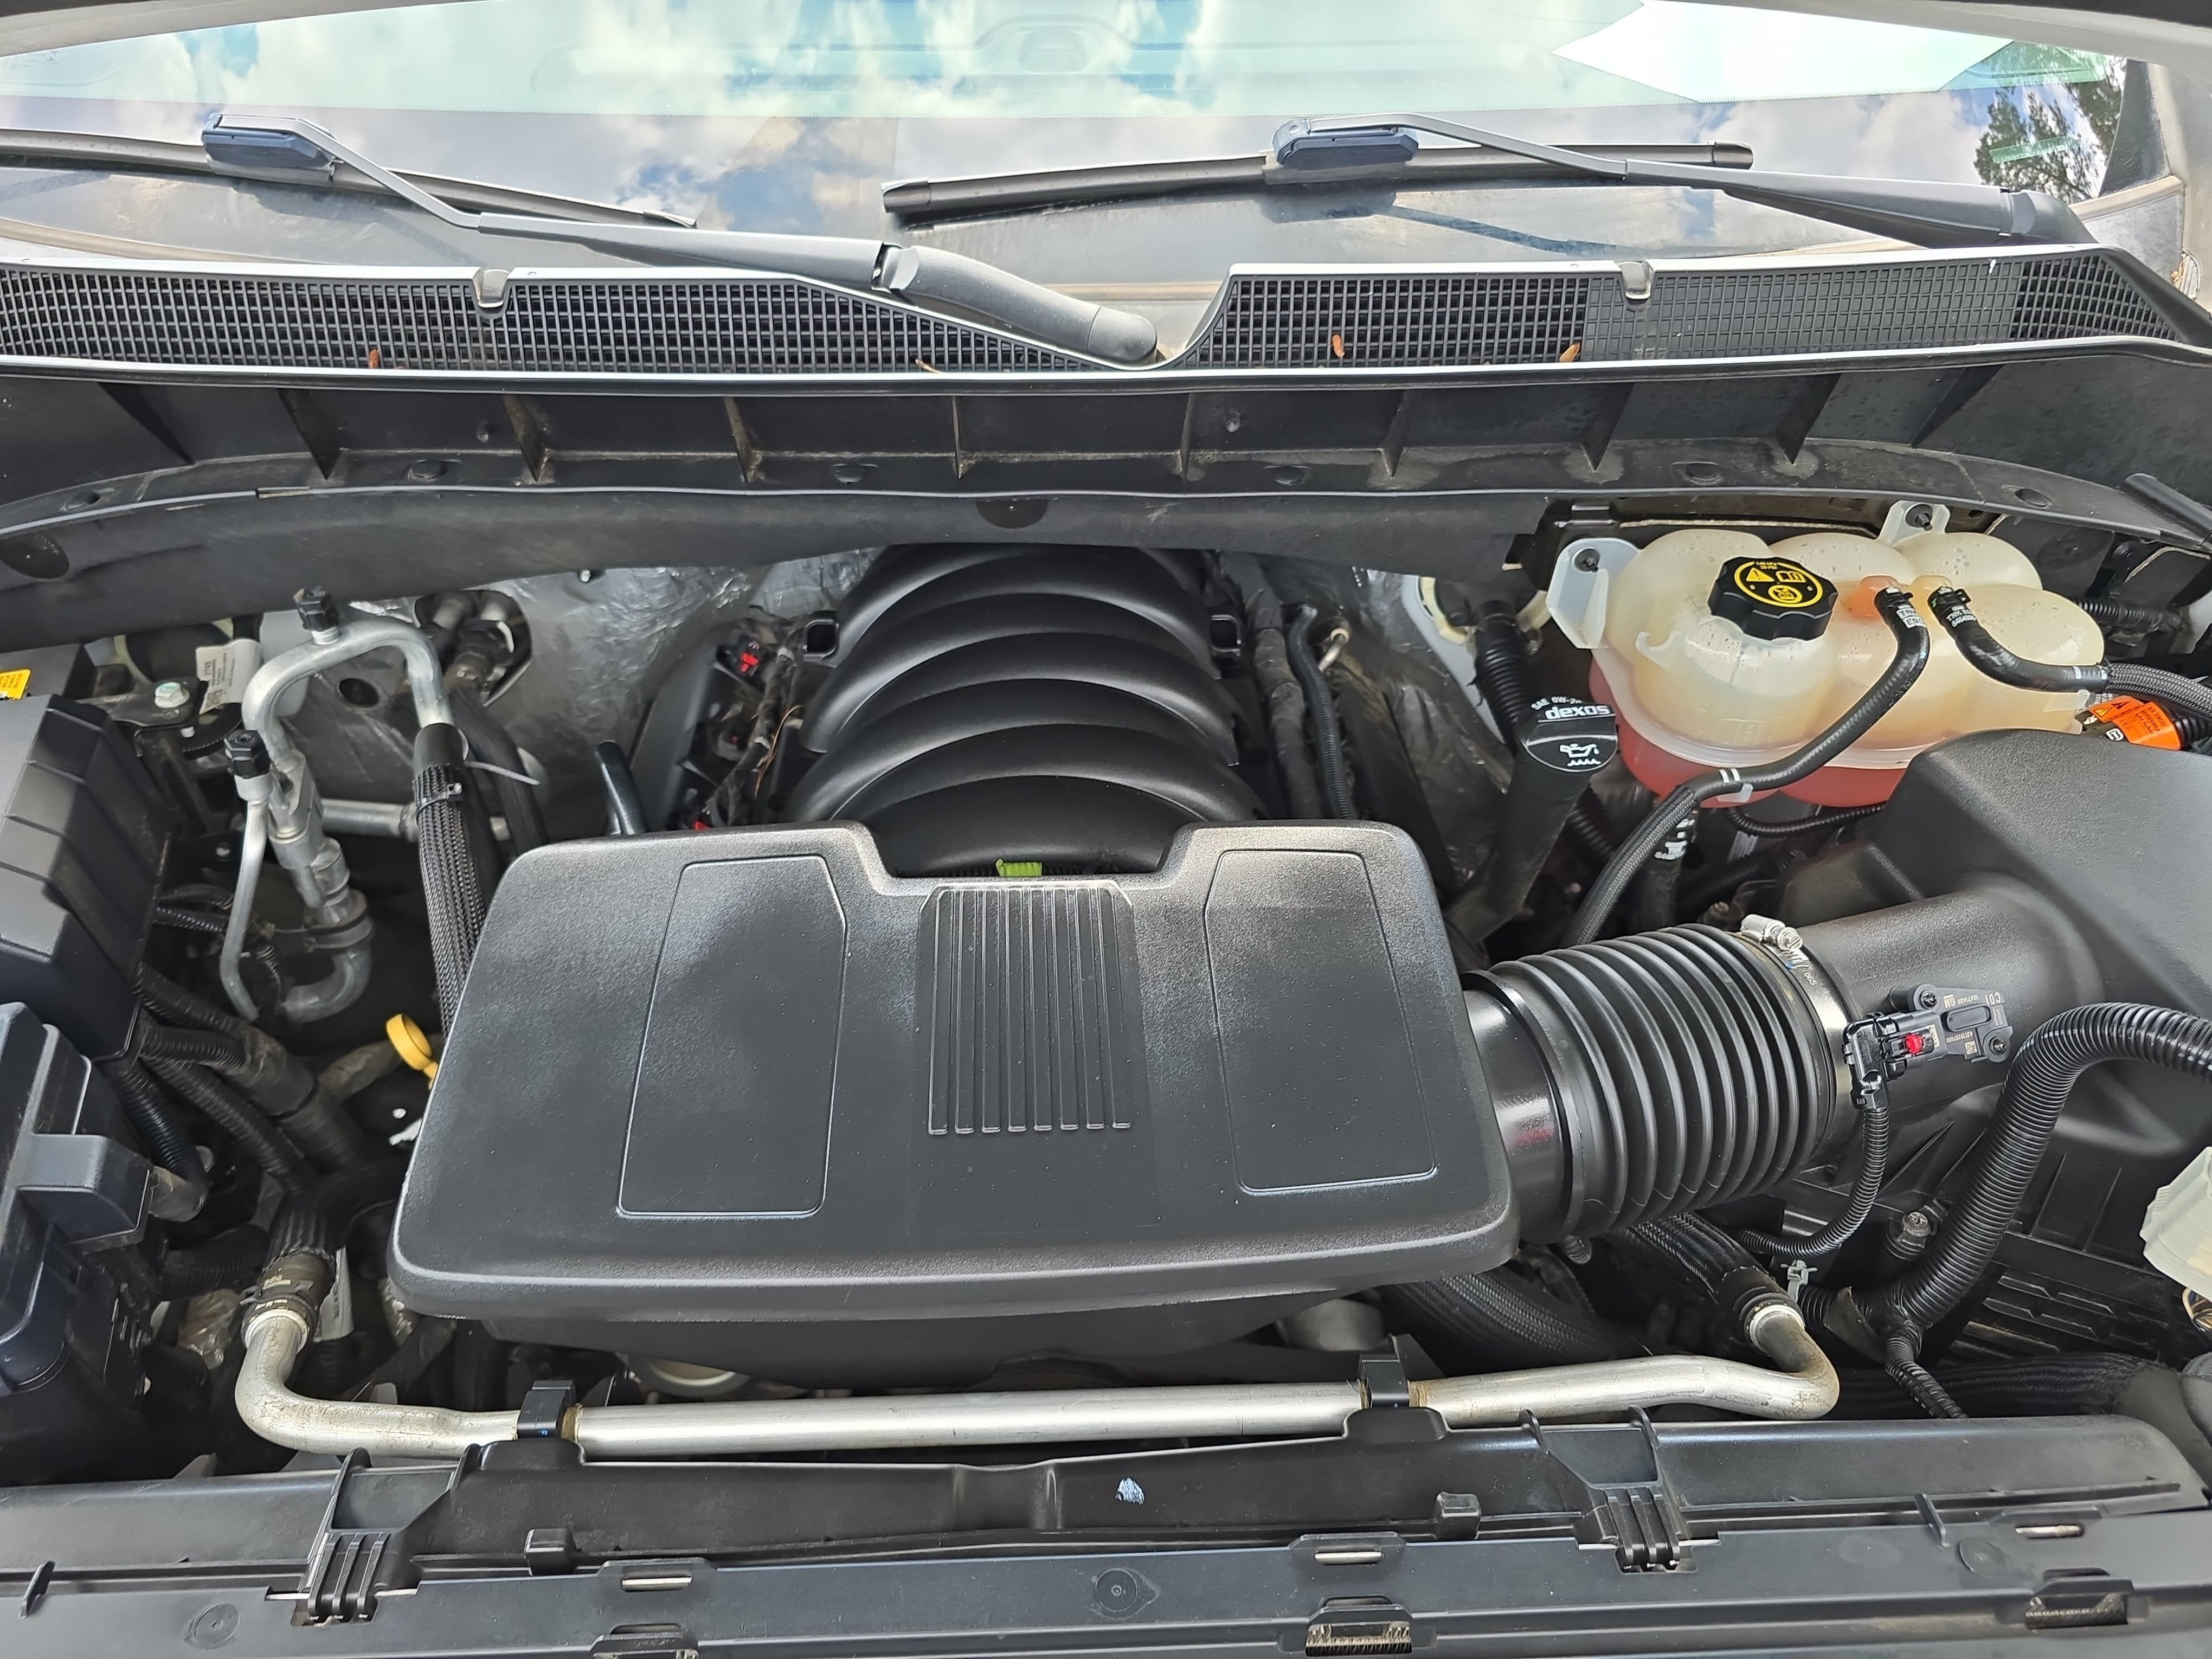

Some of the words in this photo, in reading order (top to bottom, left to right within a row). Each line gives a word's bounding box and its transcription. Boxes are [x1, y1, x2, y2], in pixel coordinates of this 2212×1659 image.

[1531, 698, 1550, 710] SAE
[1545, 705, 1610, 719] dexos
[1943, 996, 1955, 1008] GM
[1985, 992, 2001, 1005] C01
